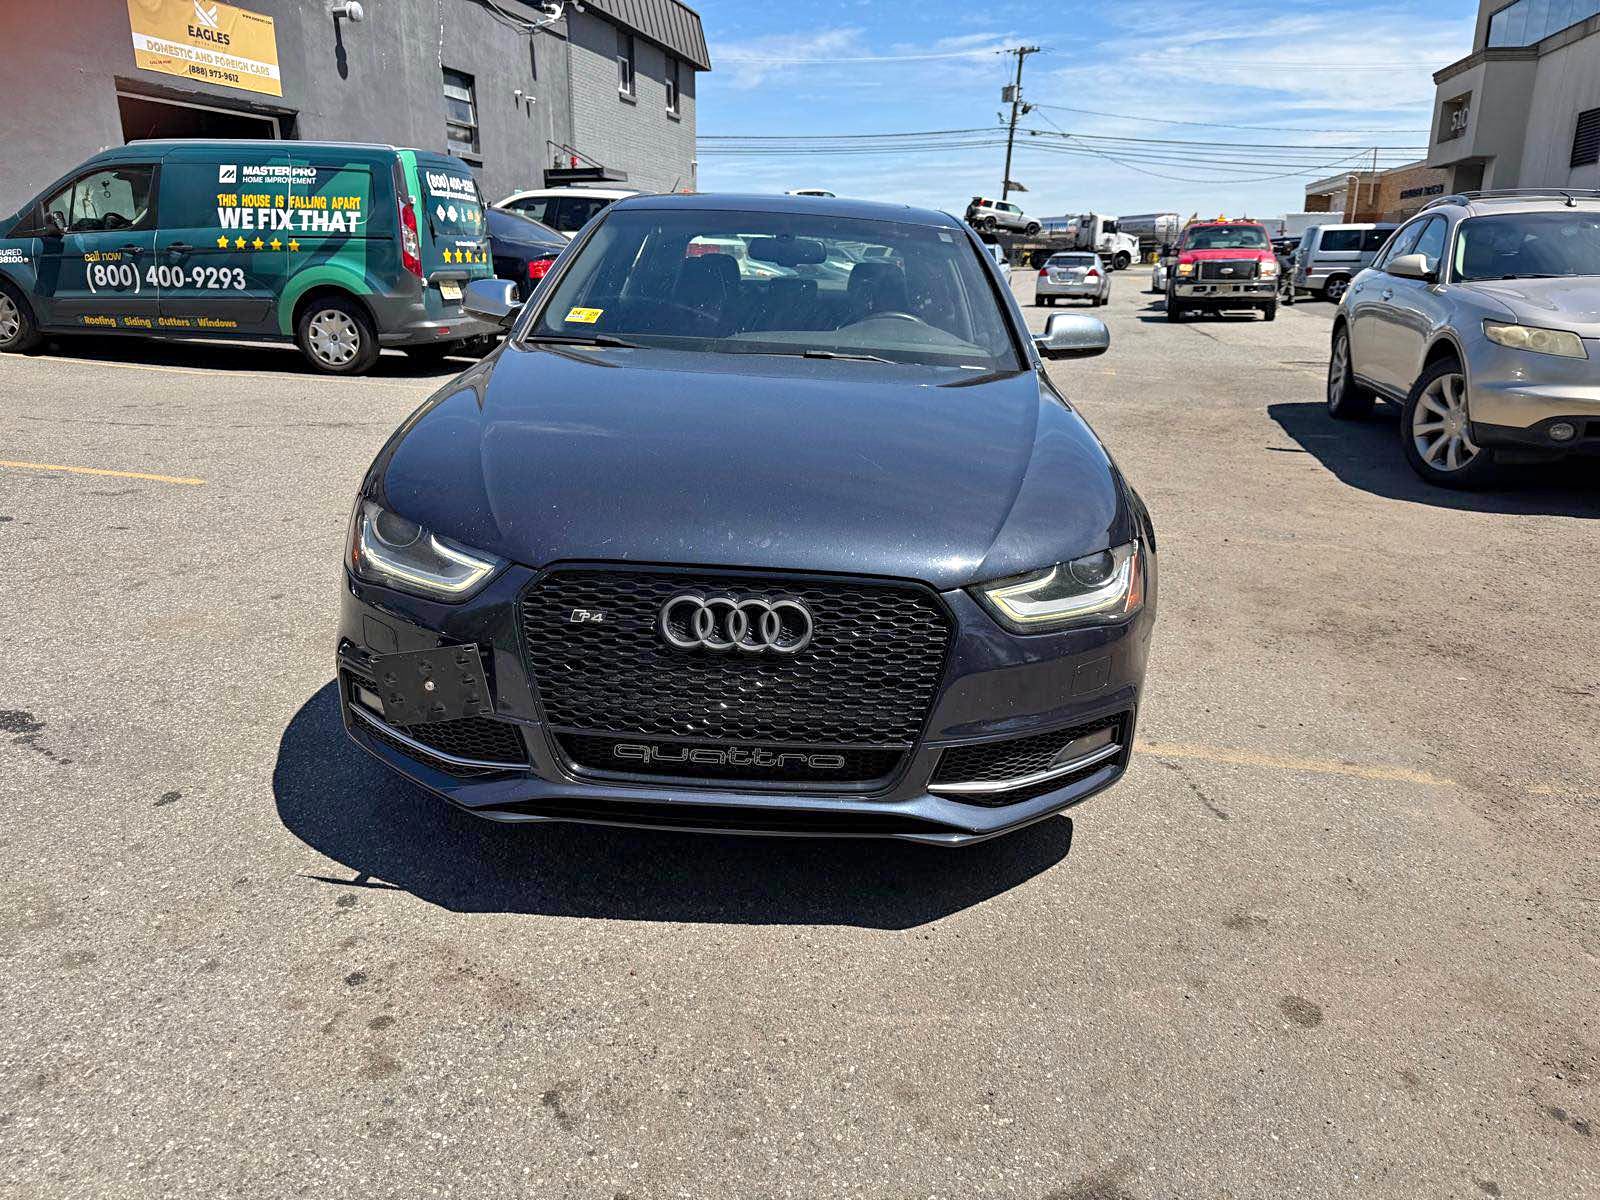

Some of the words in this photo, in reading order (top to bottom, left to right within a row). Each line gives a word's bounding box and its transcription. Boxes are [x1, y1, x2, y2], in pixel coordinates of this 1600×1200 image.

[188, 24, 230, 45] EAGLES
[146, 40, 193, 59] DOMESTIC
[195, 52, 214, 64] AND
[214, 55, 249, 72] FOREIGN
[250, 63, 270, 76] CARS
[188, 64, 208, 78] (888)
[208, 69, 240, 83] 973-9612
[264, 176, 316, 184] IMPROVEMENT
[217, 194, 237, 207] THIS
[242, 194, 270, 208] HOUSE
[276, 195, 284, 208] IS
[290, 196, 326, 209] FALLING
[332, 196, 361, 210] APART
[217, 208, 254, 230] WE
[258, 208, 294, 230] FIX
[298, 209, 361, 232] THAT
[84, 250, 100, 262] call
[102, 252, 122, 261] now
[86, 262, 140, 294] (800)
[146, 265, 246, 290] 400-9293
[84, 316, 117, 328] Roofing
[124, 316, 152, 328] Siding
[158, 316, 190, 327] Gutters
[198, 318, 238, 328] Windows
[613, 744, 845, 768] quattro
